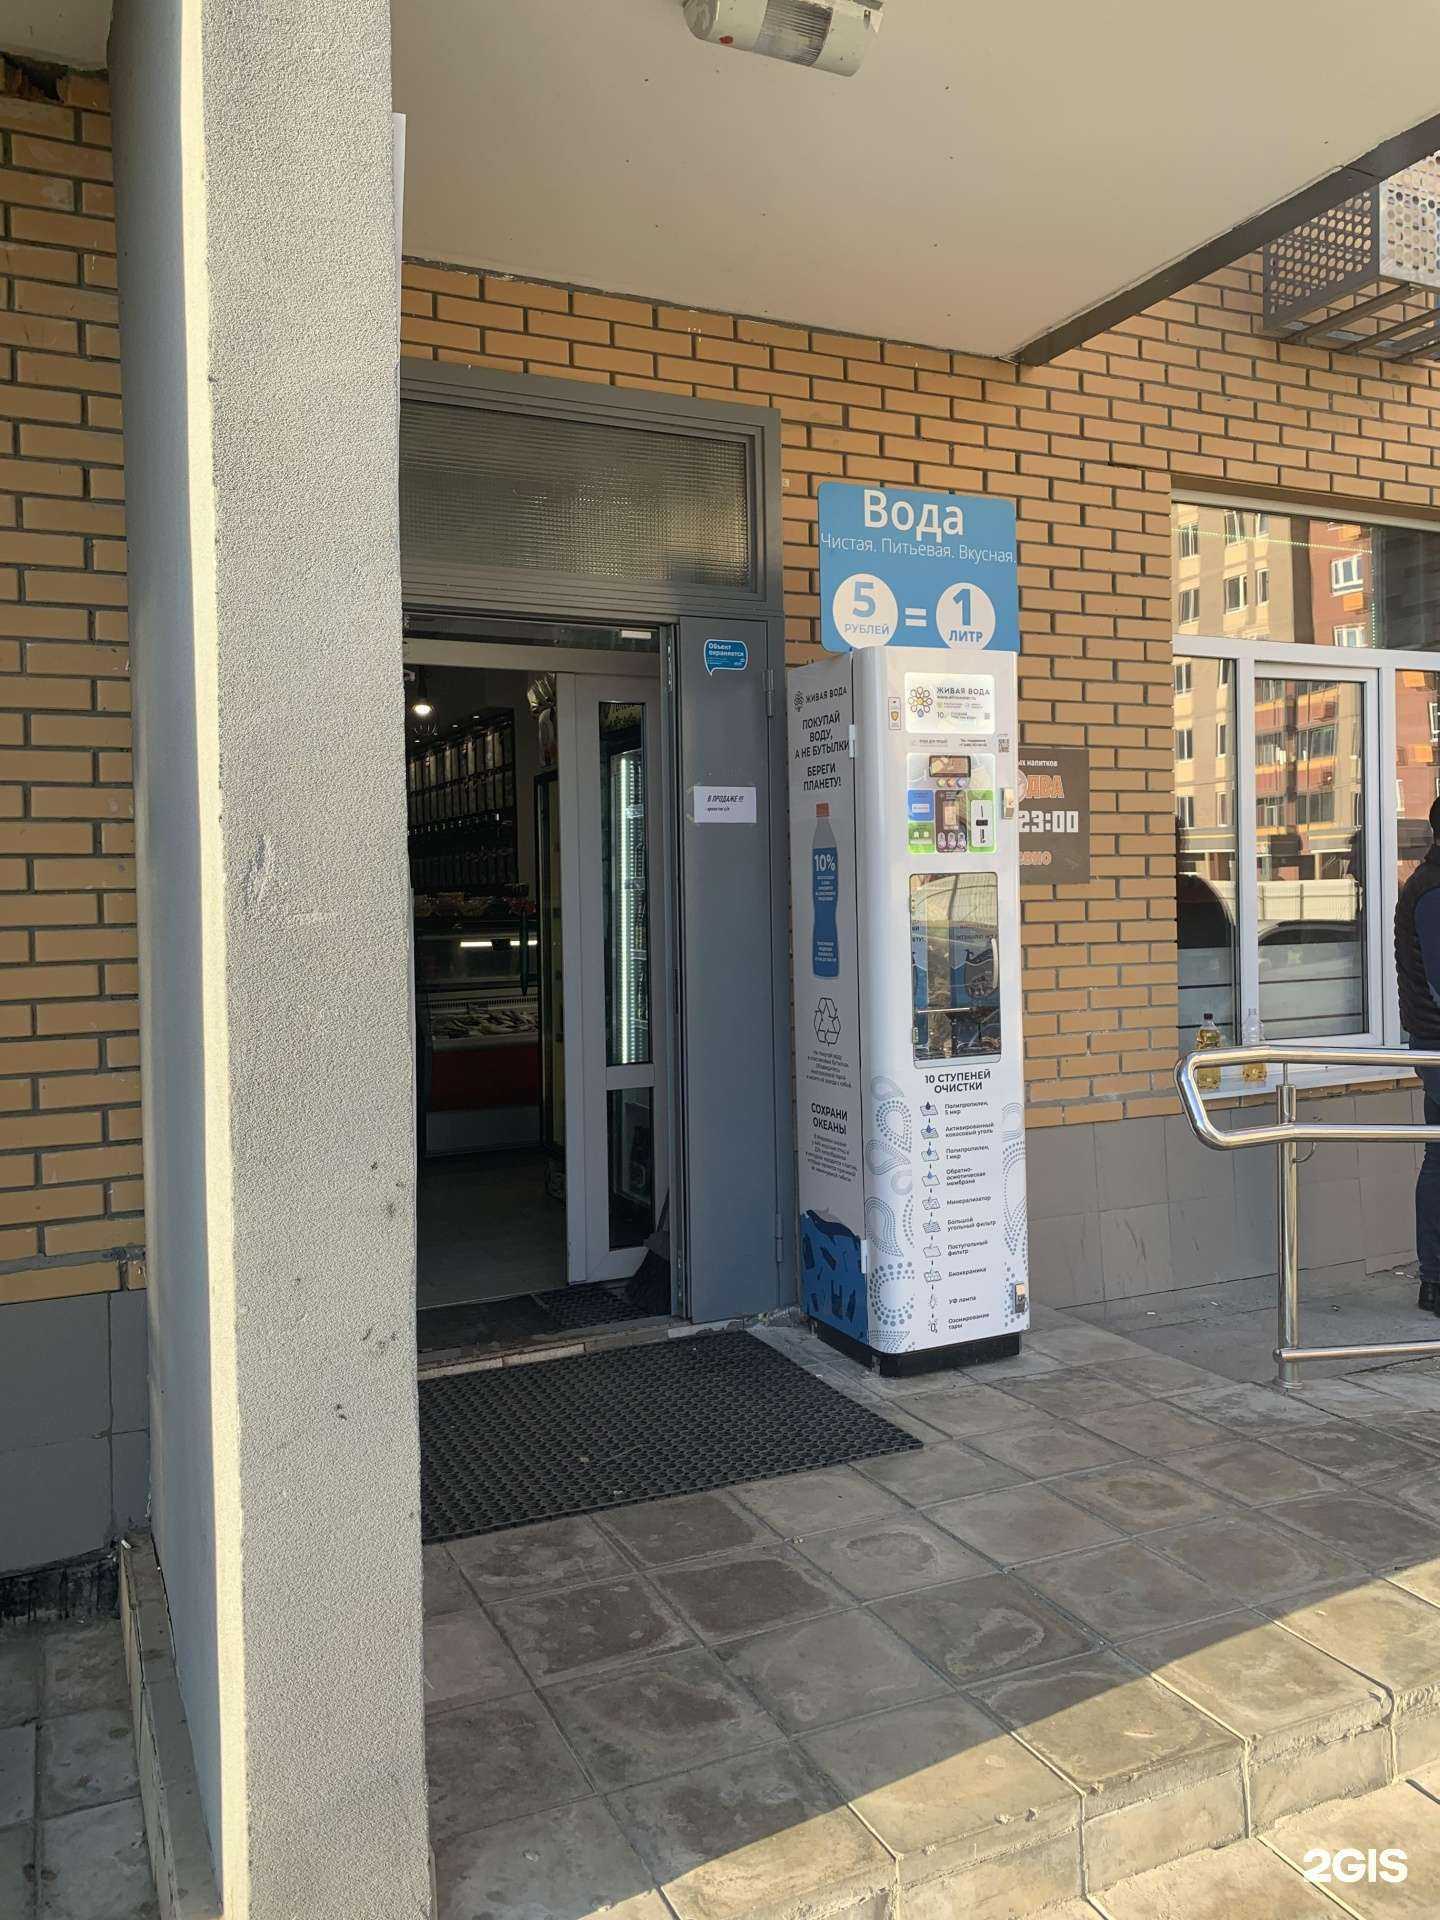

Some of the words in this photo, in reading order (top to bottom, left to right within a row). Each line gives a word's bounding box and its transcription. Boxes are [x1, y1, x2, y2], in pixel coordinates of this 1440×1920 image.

[864, 490, 963, 543] Вода
[820, 532, 877, 552] Чистая.
[881, 538, 955, 559] Питьевая.
[959, 545, 1017, 565] Вкусная.
[852, 581, 876, 618] 5
[952, 588, 972, 627] 1
[844, 623, 890, 635] РУБЛЕЙ
[949, 630, 983, 643] ЛИТР
[806, 690, 828, 703] ЖИВАЯ
[829, 685, 847, 698] ВОДА
[936, 687, 966, 696] ЖИВАЯ
[968, 688, 990, 697] ВОДА
[802, 710, 840, 730] ПОКУПАЙ
[937, 711, 944, 719] 10
[809, 728, 833, 742] ВОДУ,
[795, 749, 800, 759] А
[801, 746, 811, 758] НЕ
[812, 740, 849, 756] БУТЫЛКИ
[807, 762, 836, 777] БЕРЕГИ
[803, 777, 841, 791] ПЛАНЕТУ!
[1018, 810, 1079, 833] 23:00
[814, 854, 836, 872] 10%
[925, 1075, 935, 1084] 10
[937, 1069, 991, 1083] СТУПЕНЕЙ
[934, 1082, 983, 1094] ОЧИСТКИ
[811, 1102, 848, 1122] СОХРАНИ
[812, 1117, 847, 1135] ОКЕАНЫ
[946, 1167, 973, 1175] Обратно-
